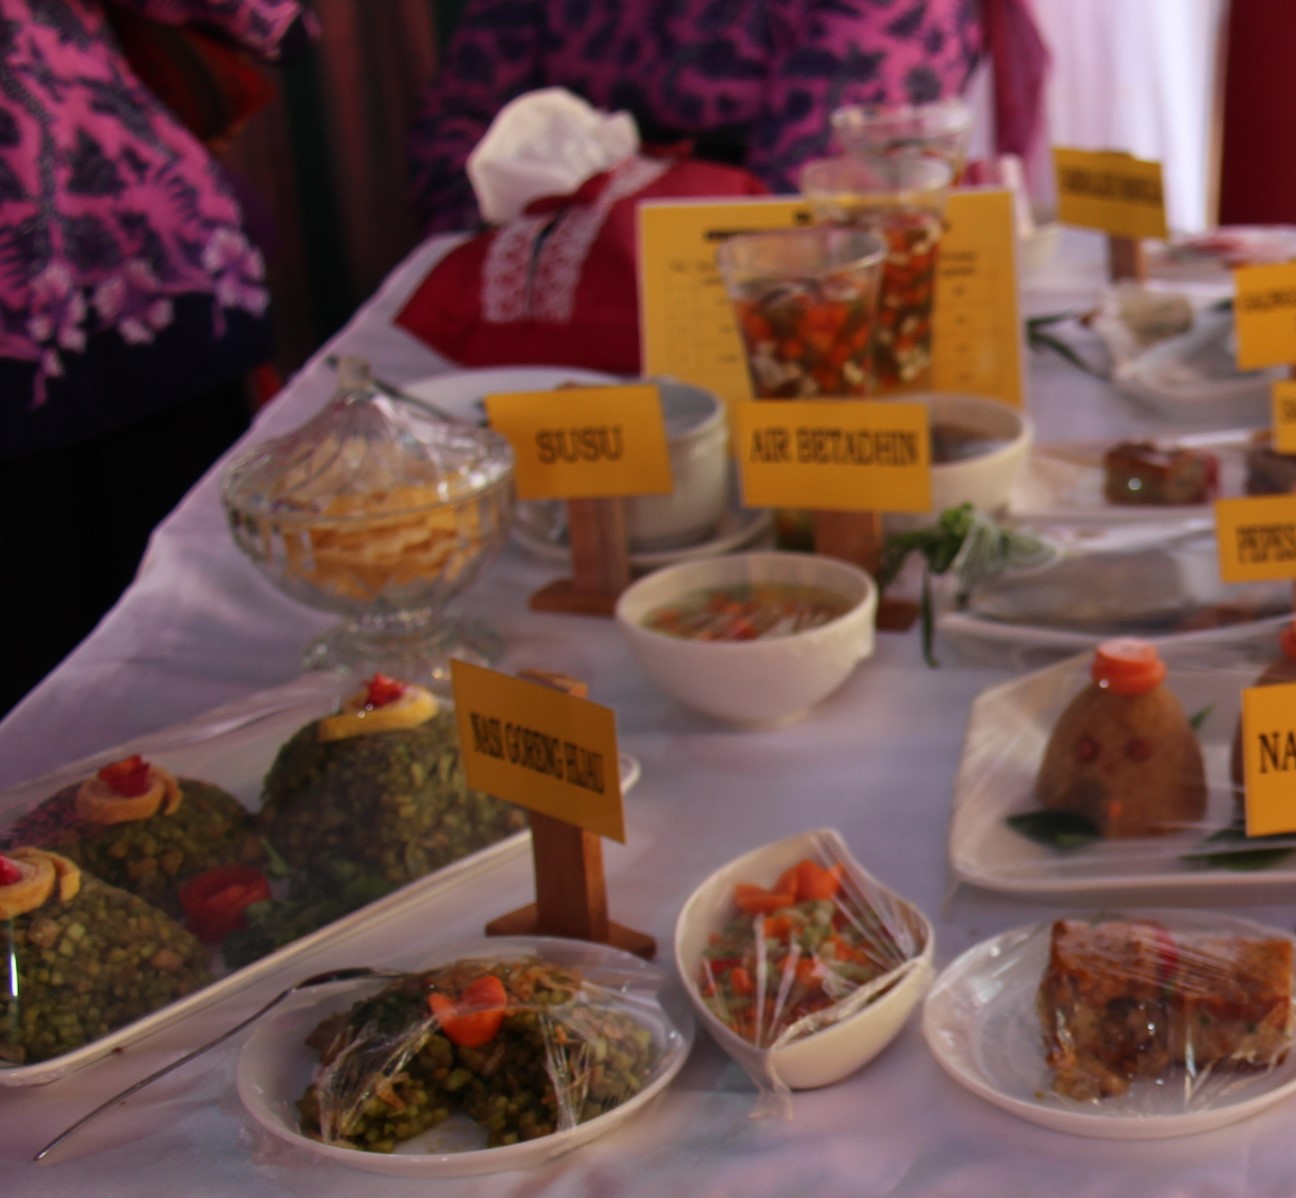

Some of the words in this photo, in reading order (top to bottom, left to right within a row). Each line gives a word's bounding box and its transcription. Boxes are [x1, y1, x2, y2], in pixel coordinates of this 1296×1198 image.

[535, 425, 625, 465] SUSU
[751, 429, 790, 463] AIR
[800, 428, 919, 467] BETADHIN
[1236, 523, 1296, 565] PEPES
[469, 712, 505, 761] NASI
[505, 722, 564, 780] GORENG
[563, 741, 605, 795] HIJAU
